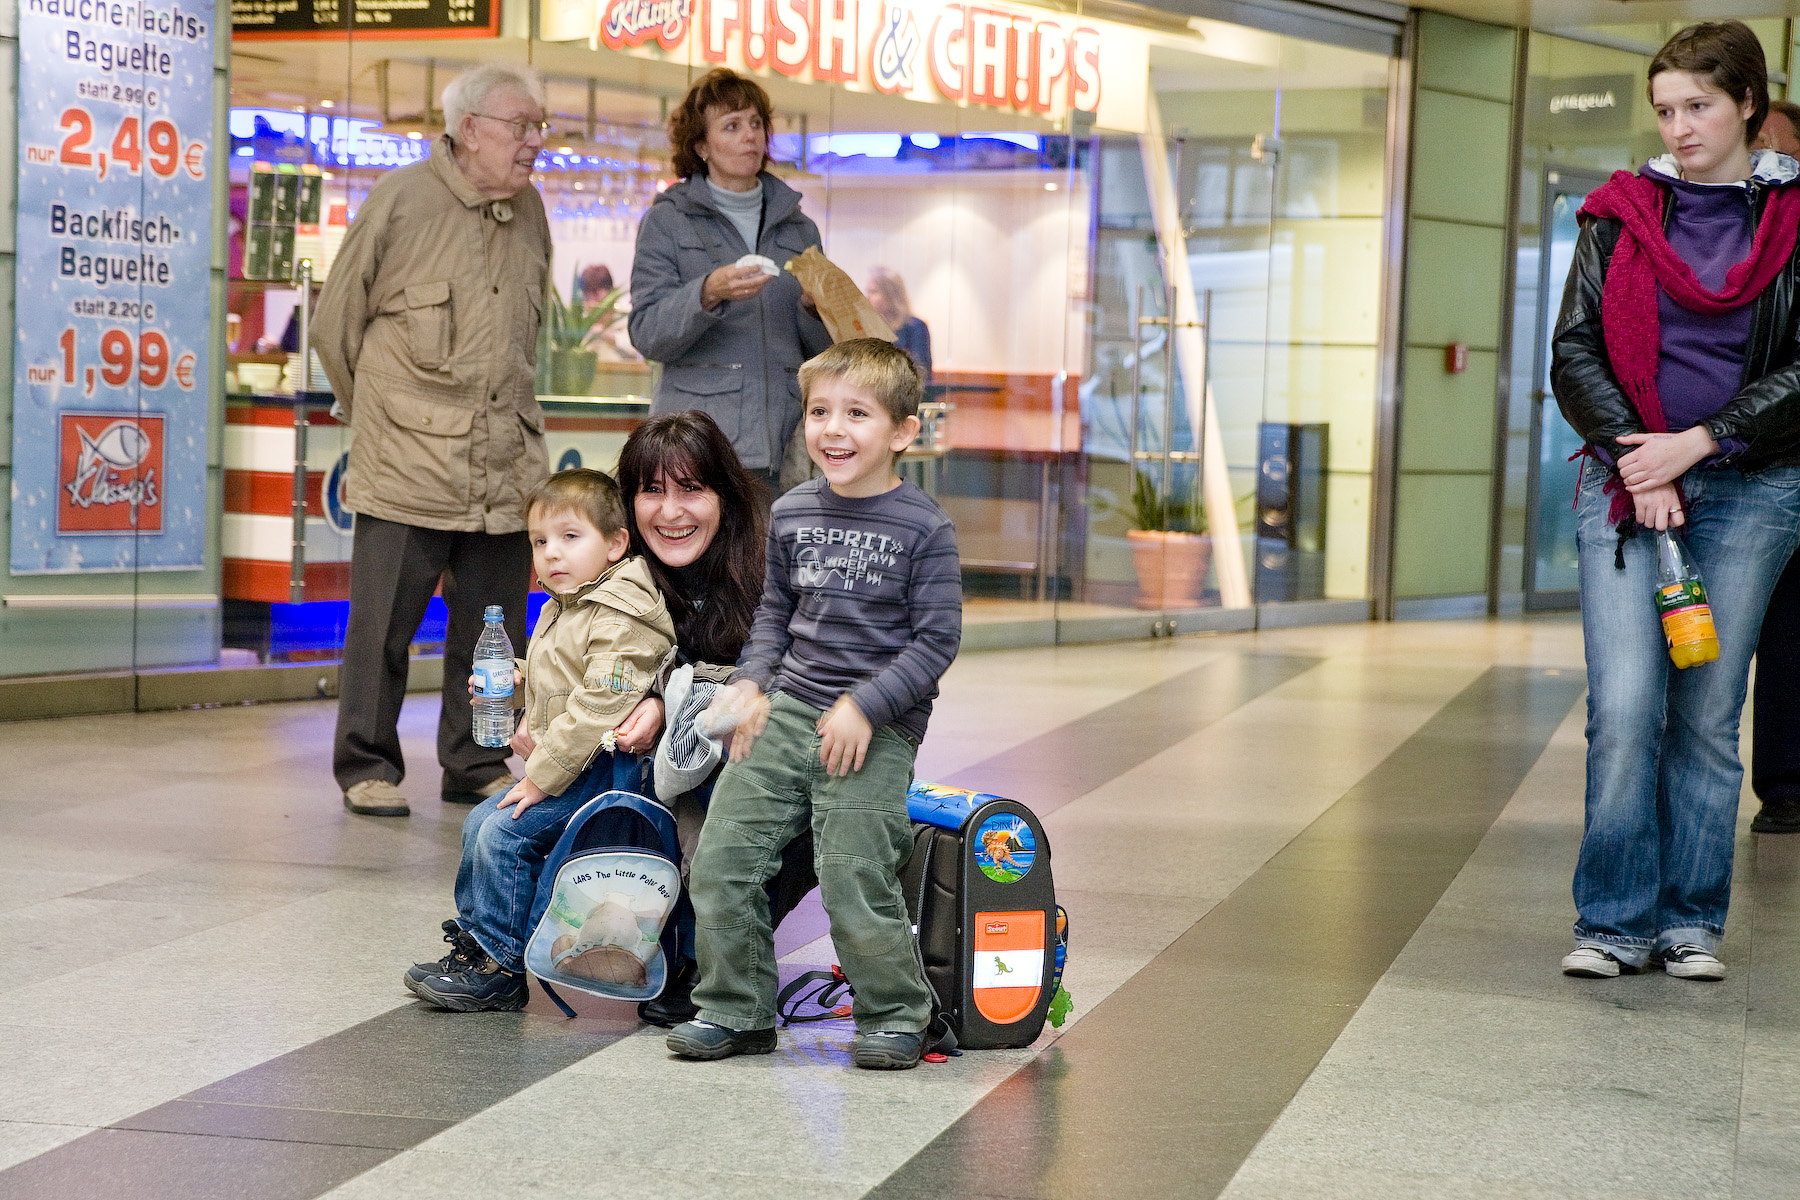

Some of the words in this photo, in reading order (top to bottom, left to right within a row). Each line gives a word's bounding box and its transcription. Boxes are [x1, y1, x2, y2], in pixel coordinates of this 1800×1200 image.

[66, 30, 171, 75] Baguette
[873, 3, 920, 94] &
[78, 80, 109, 99] statt
[27, 145, 55, 162] nur
[51, 204, 180, 244] Backfisch-
[60, 246, 169, 285] Baguette
[73, 299, 105, 315] statt
[28, 365, 55, 383] nur
[796, 527, 893, 553] ESPRIT
[849, 548, 889, 565] PLAY
[573, 873, 592, 885] LARS
[595, 870, 611, 879] The
[615, 869, 636, 879] Little
